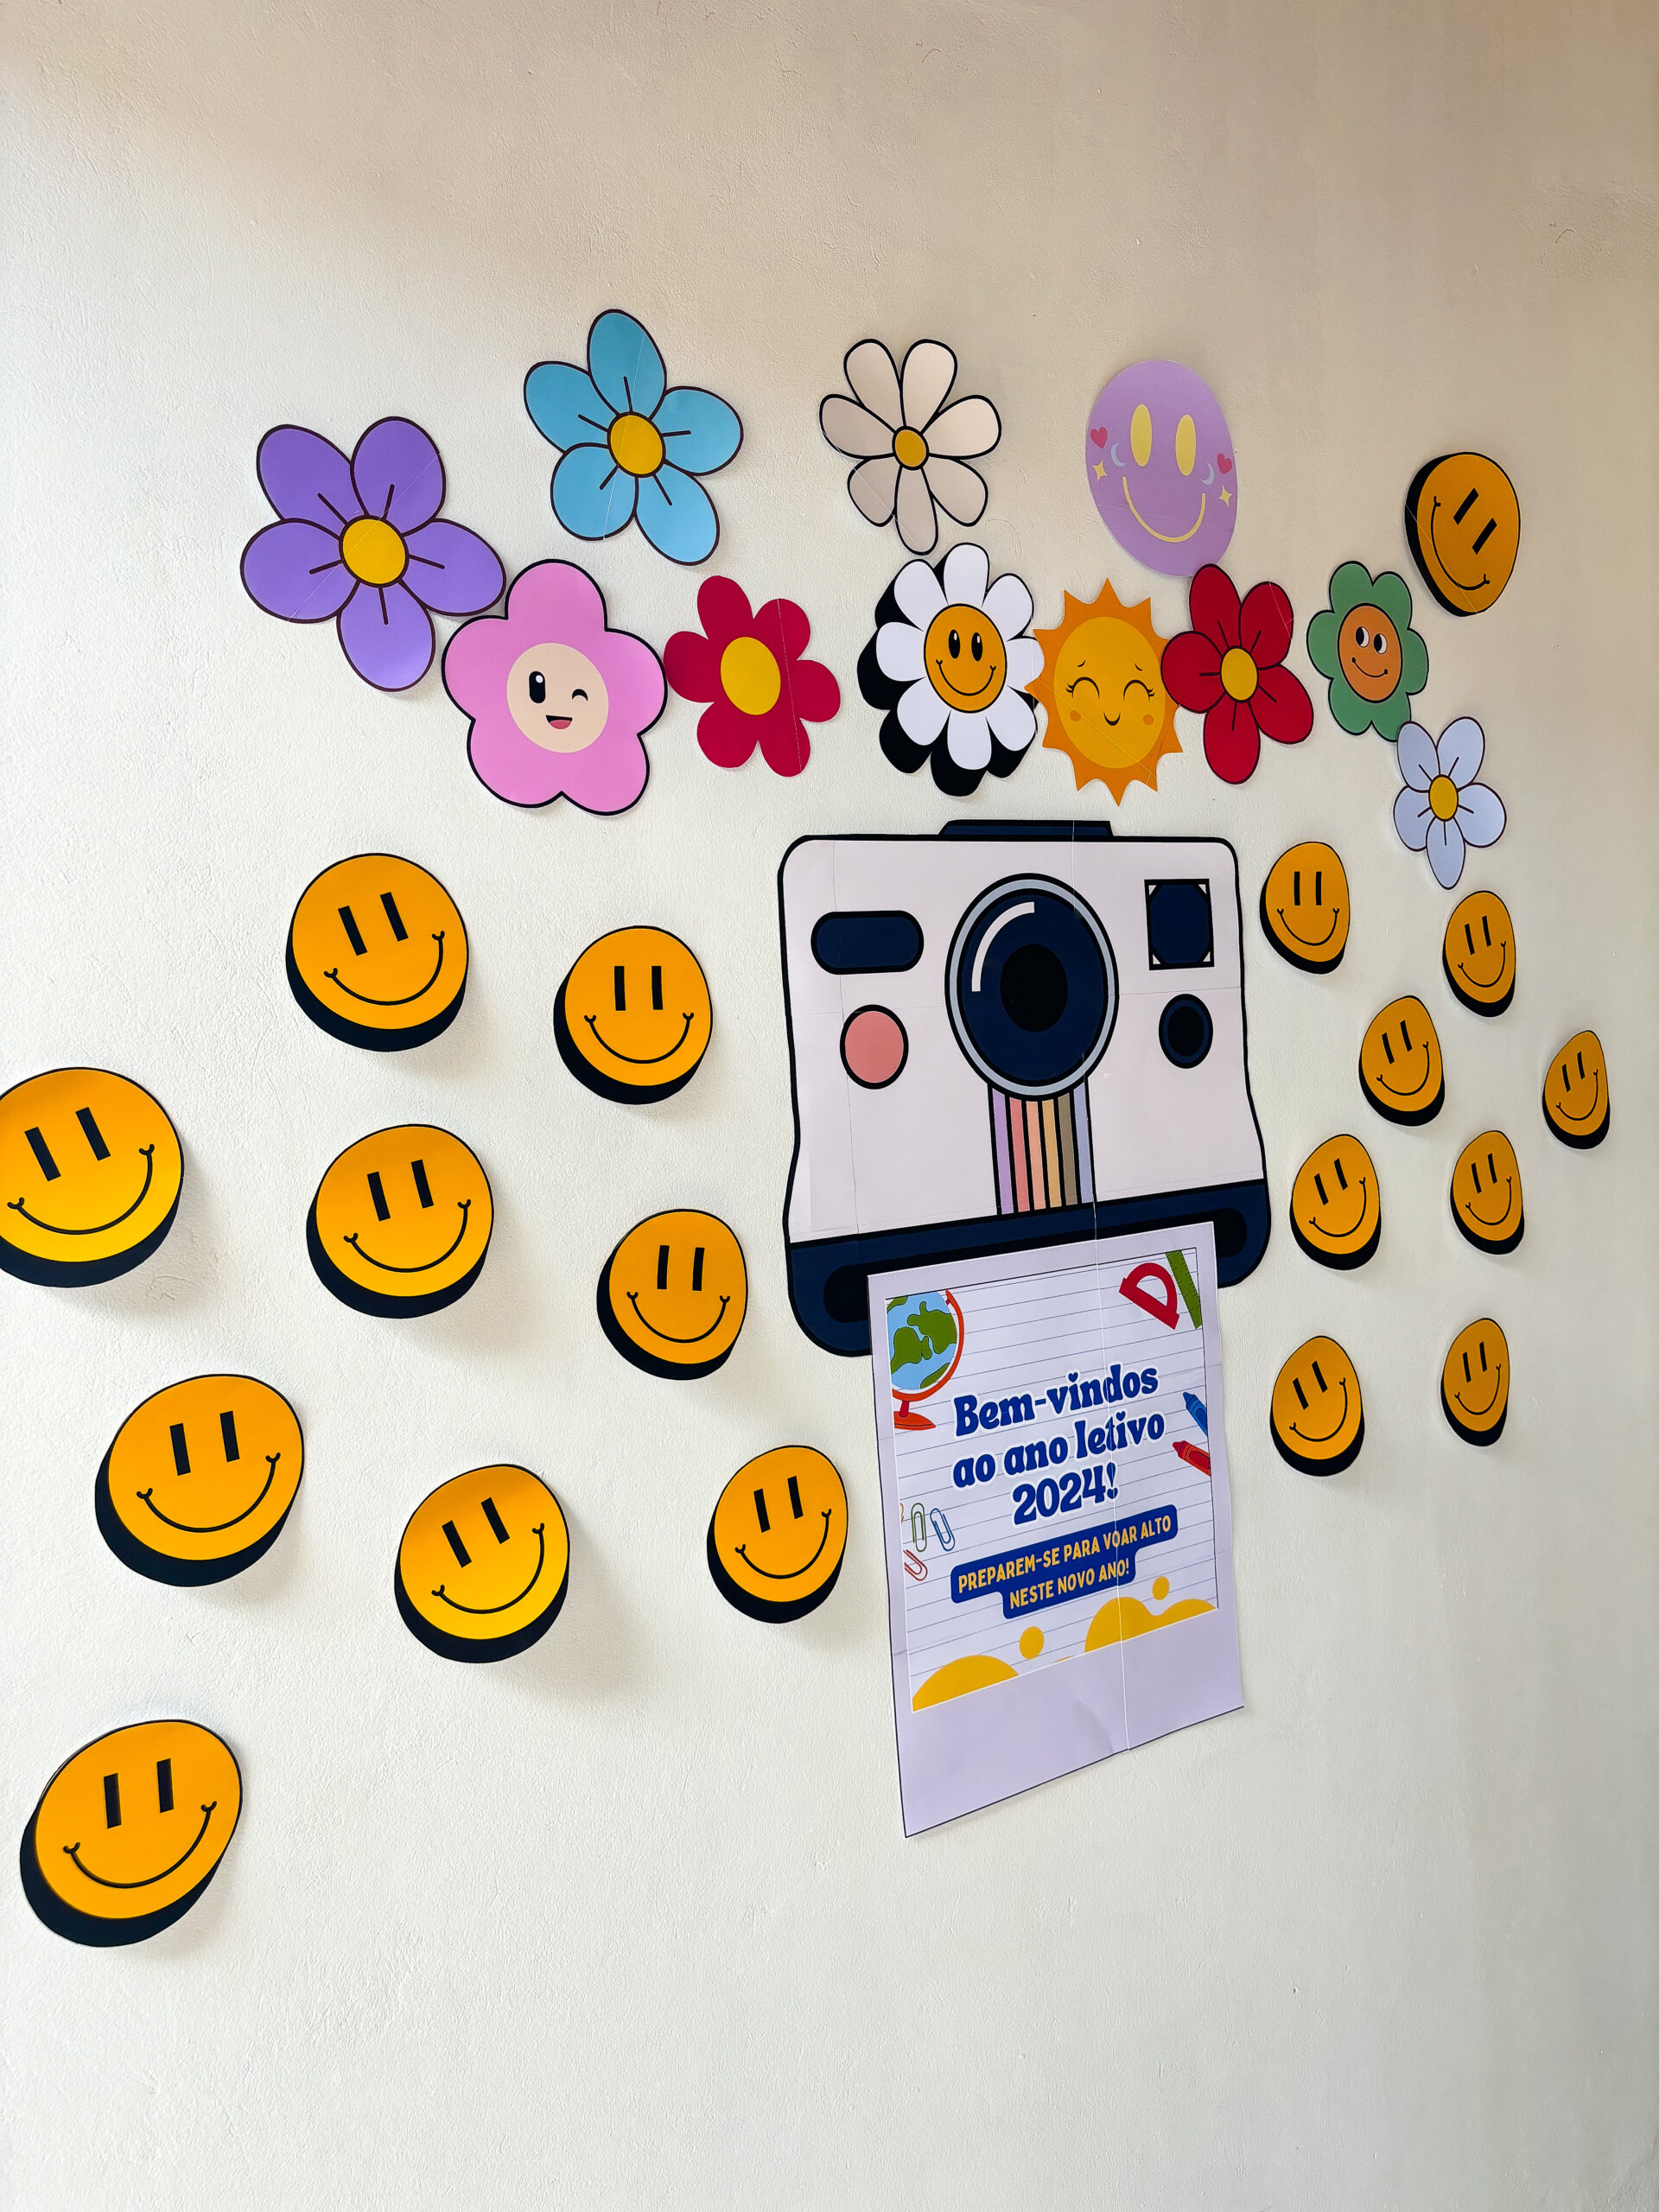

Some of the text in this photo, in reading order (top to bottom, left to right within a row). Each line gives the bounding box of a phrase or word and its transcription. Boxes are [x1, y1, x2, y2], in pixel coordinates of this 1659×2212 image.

[953, 1363, 1158, 1436] Bem-vindos
[953, 1411, 1165, 1488] ao ano letivo
[1013, 1462, 1118, 1525] 2024!
[958, 1515, 1171, 1593] PREPAREM-SE PARA VOAR ALTO
[1009, 1558, 1129, 1610] NESTE NOVO ANO!
